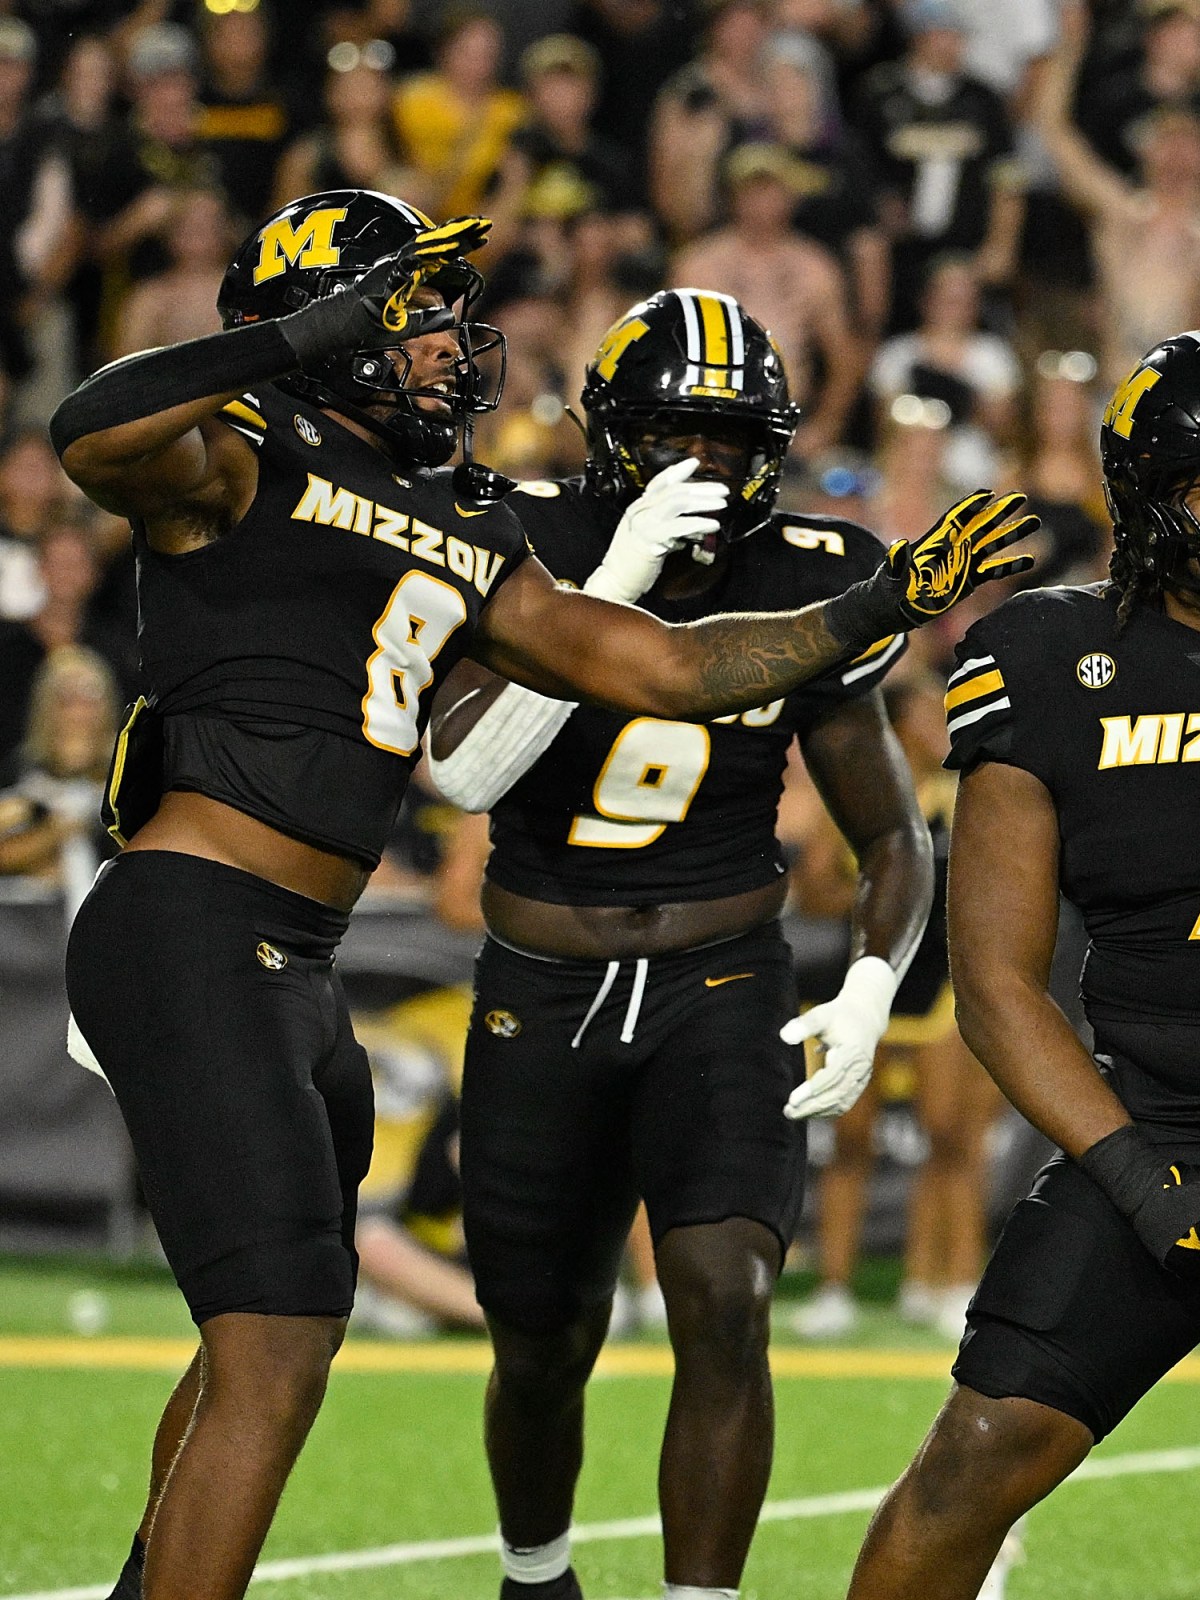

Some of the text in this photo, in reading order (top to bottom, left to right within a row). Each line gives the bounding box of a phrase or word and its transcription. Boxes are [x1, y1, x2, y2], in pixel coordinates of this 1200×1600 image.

[253, 208, 348, 286] M
[296, 416, 320, 444] SEC
[1102, 358, 1163, 440] M
[291, 472, 506, 598] MIZZOU
[362, 569, 467, 757] 8
[1079, 654, 1113, 687] SEC
[567, 716, 711, 849] 9
